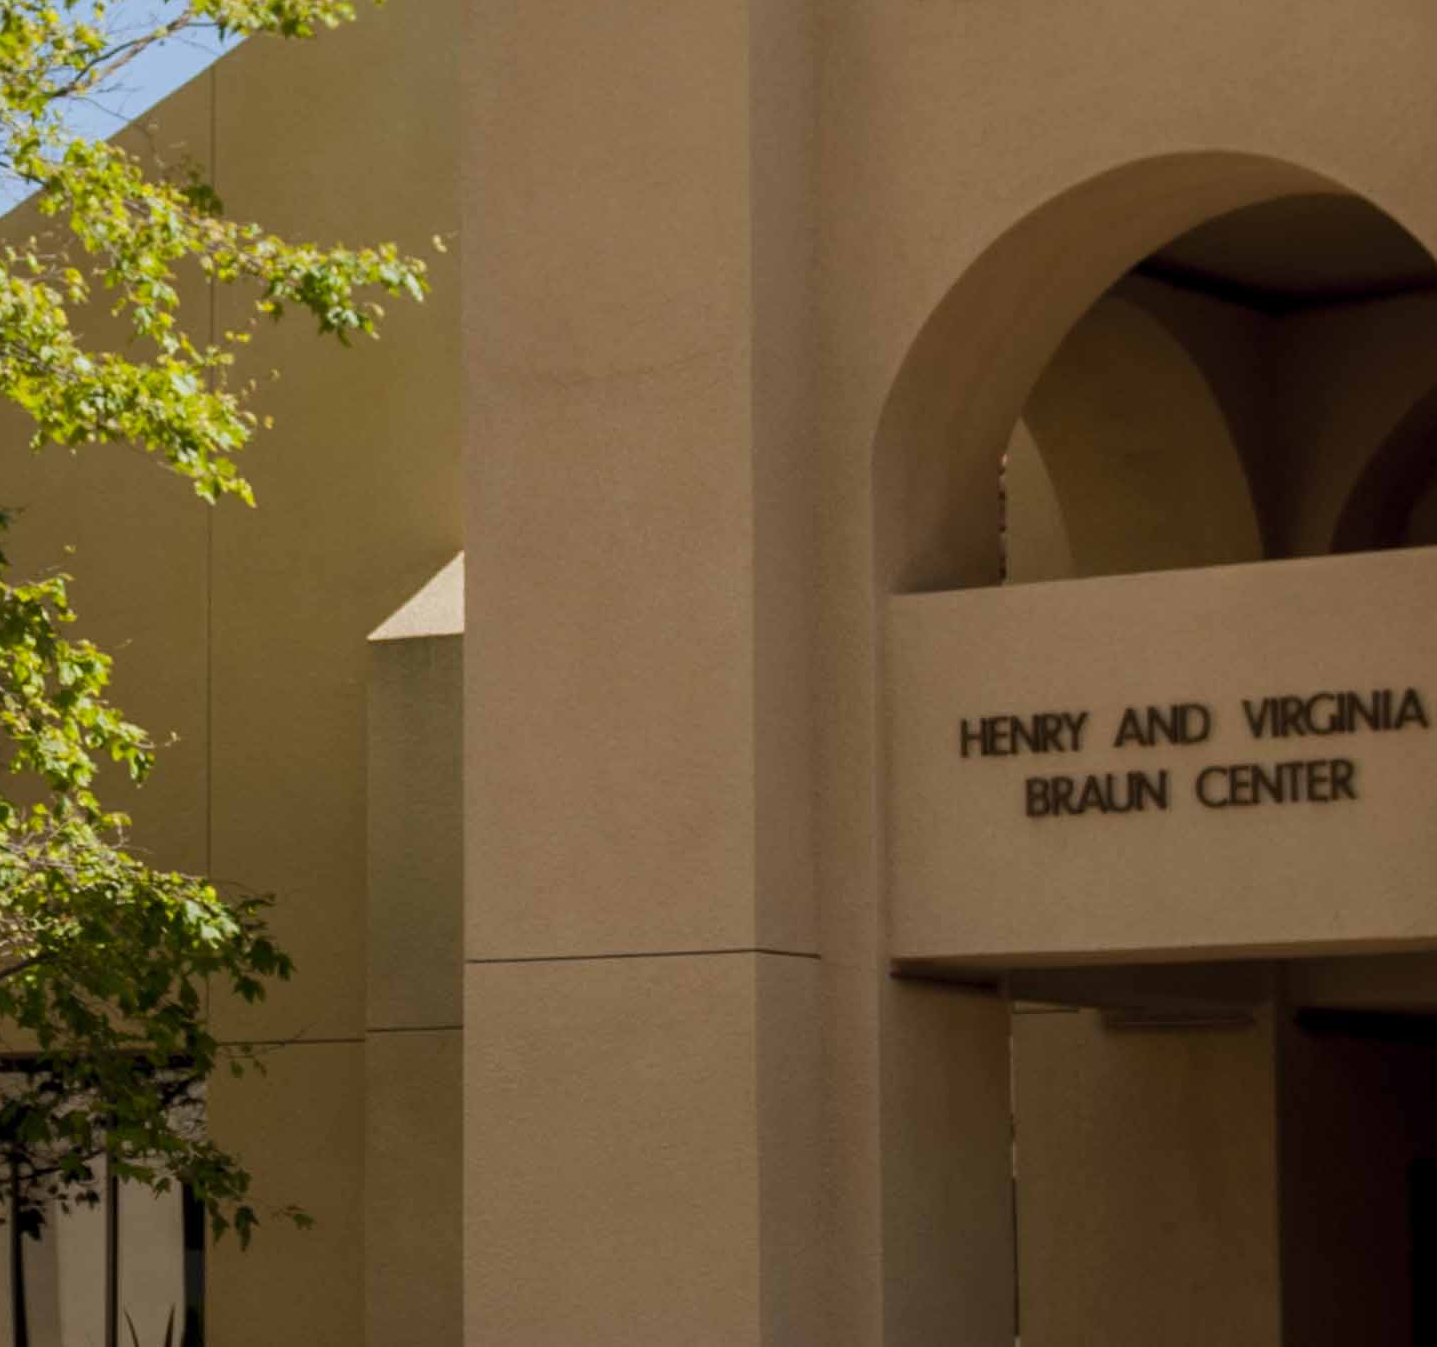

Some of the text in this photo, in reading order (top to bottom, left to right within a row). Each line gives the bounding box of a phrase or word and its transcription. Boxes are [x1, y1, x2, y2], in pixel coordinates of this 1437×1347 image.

[960, 687, 1431, 759] HENRY AND VIRGINIA
[1025, 757, 1358, 819] BRAUN CENTER
